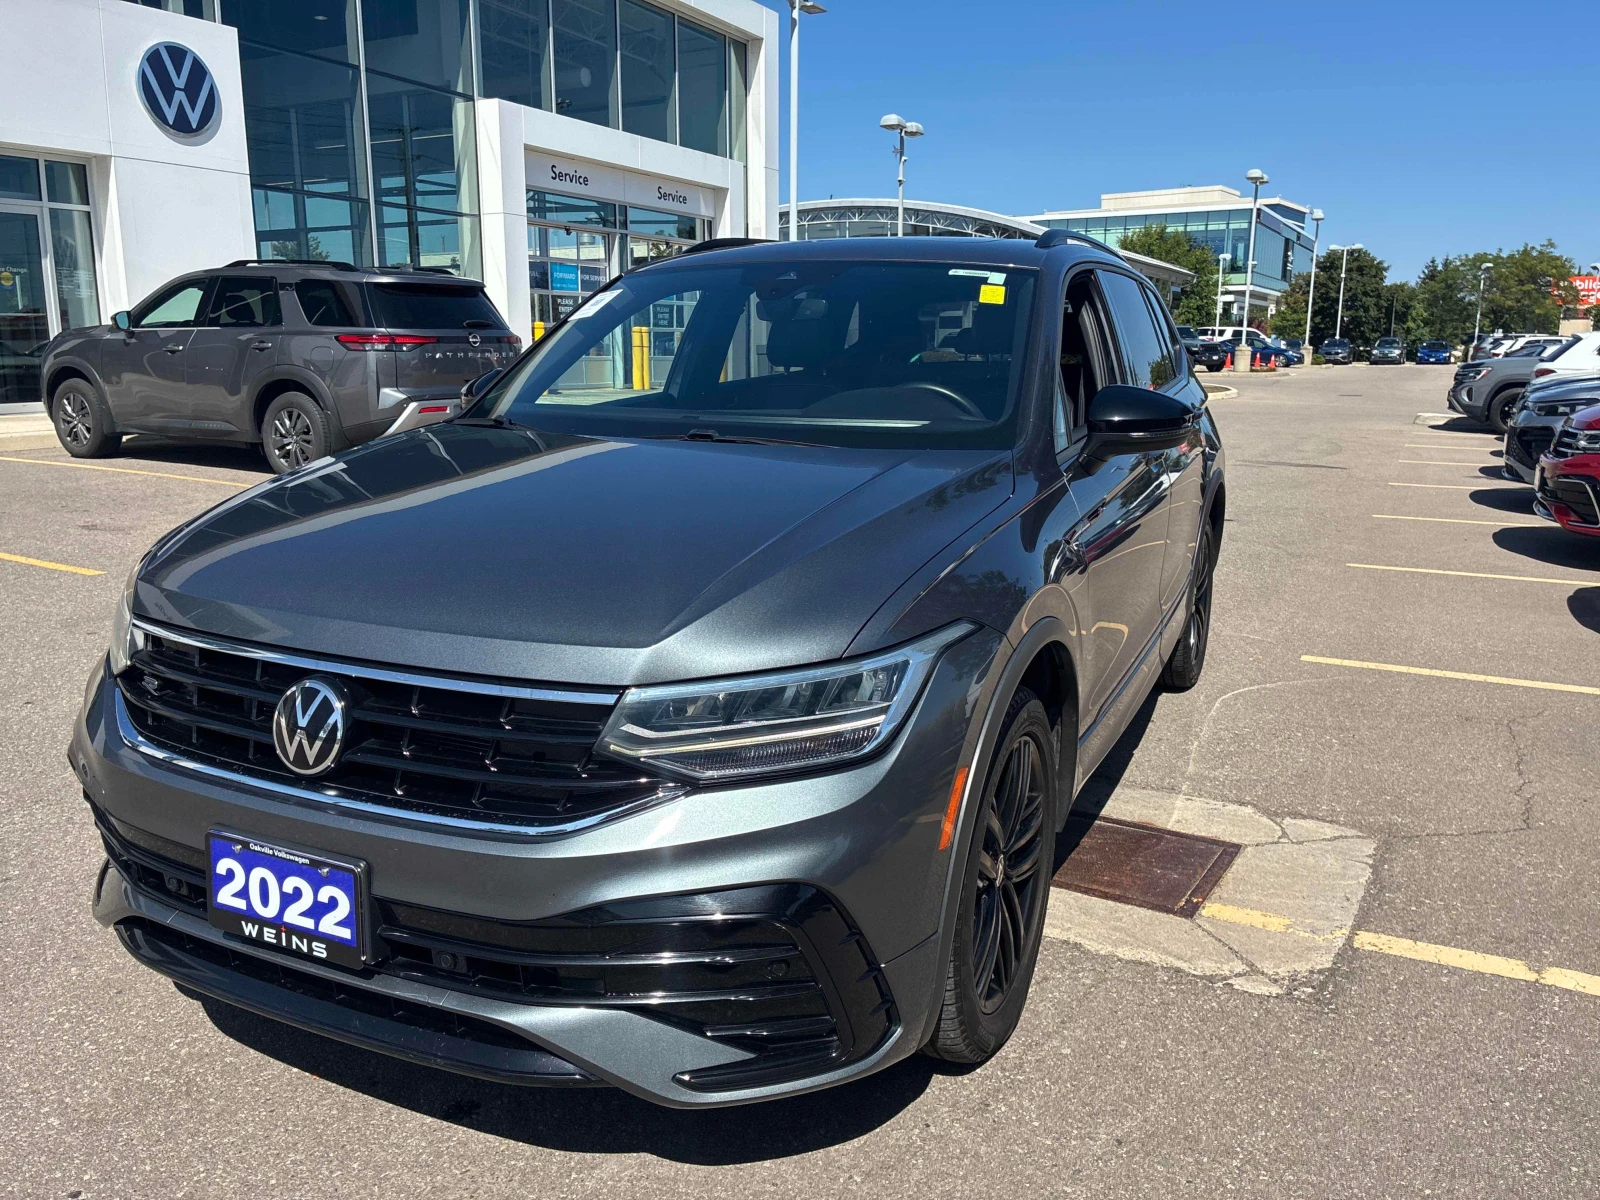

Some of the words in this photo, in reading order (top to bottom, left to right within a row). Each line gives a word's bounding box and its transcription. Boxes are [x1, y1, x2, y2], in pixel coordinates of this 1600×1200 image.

[138, 41, 217, 134] VW
[550, 164, 589, 187] Service
[657, 186, 688, 205] Service
[553, 272, 576, 280] FORWARD
[557, 298, 574, 306] PLEASE
[273, 680, 345, 773] VW
[249, 843, 274, 856] Oakville
[273, 849, 310, 865] Volkswagen
[215, 857, 352, 940] 2022
